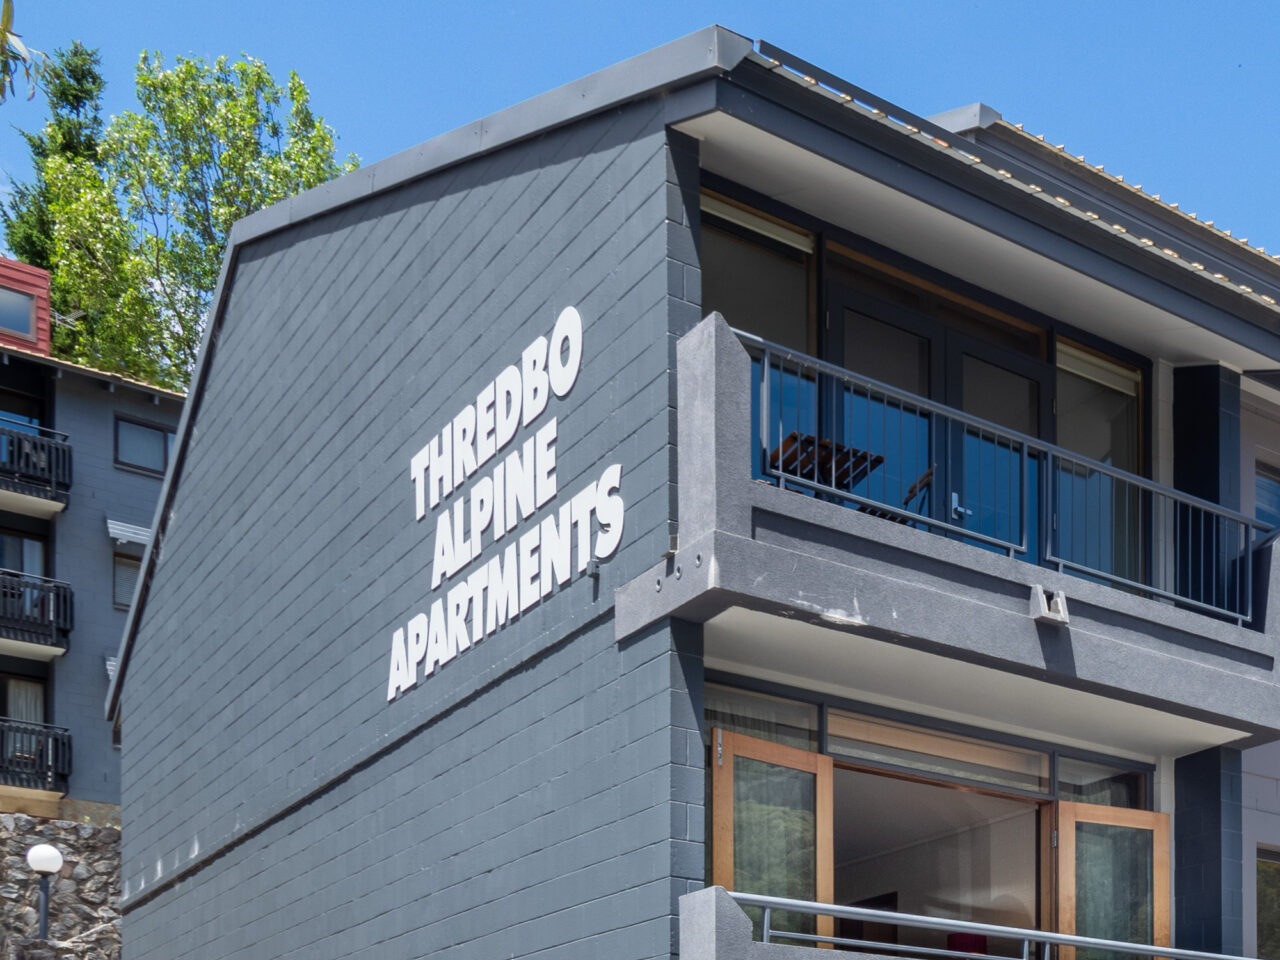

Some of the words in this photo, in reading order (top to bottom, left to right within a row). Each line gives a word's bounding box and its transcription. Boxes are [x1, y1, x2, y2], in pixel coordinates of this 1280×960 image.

[411, 306, 583, 521] THREDBO
[431, 417, 557, 590] ALPINE
[387, 464, 624, 701] APARTMENTS
